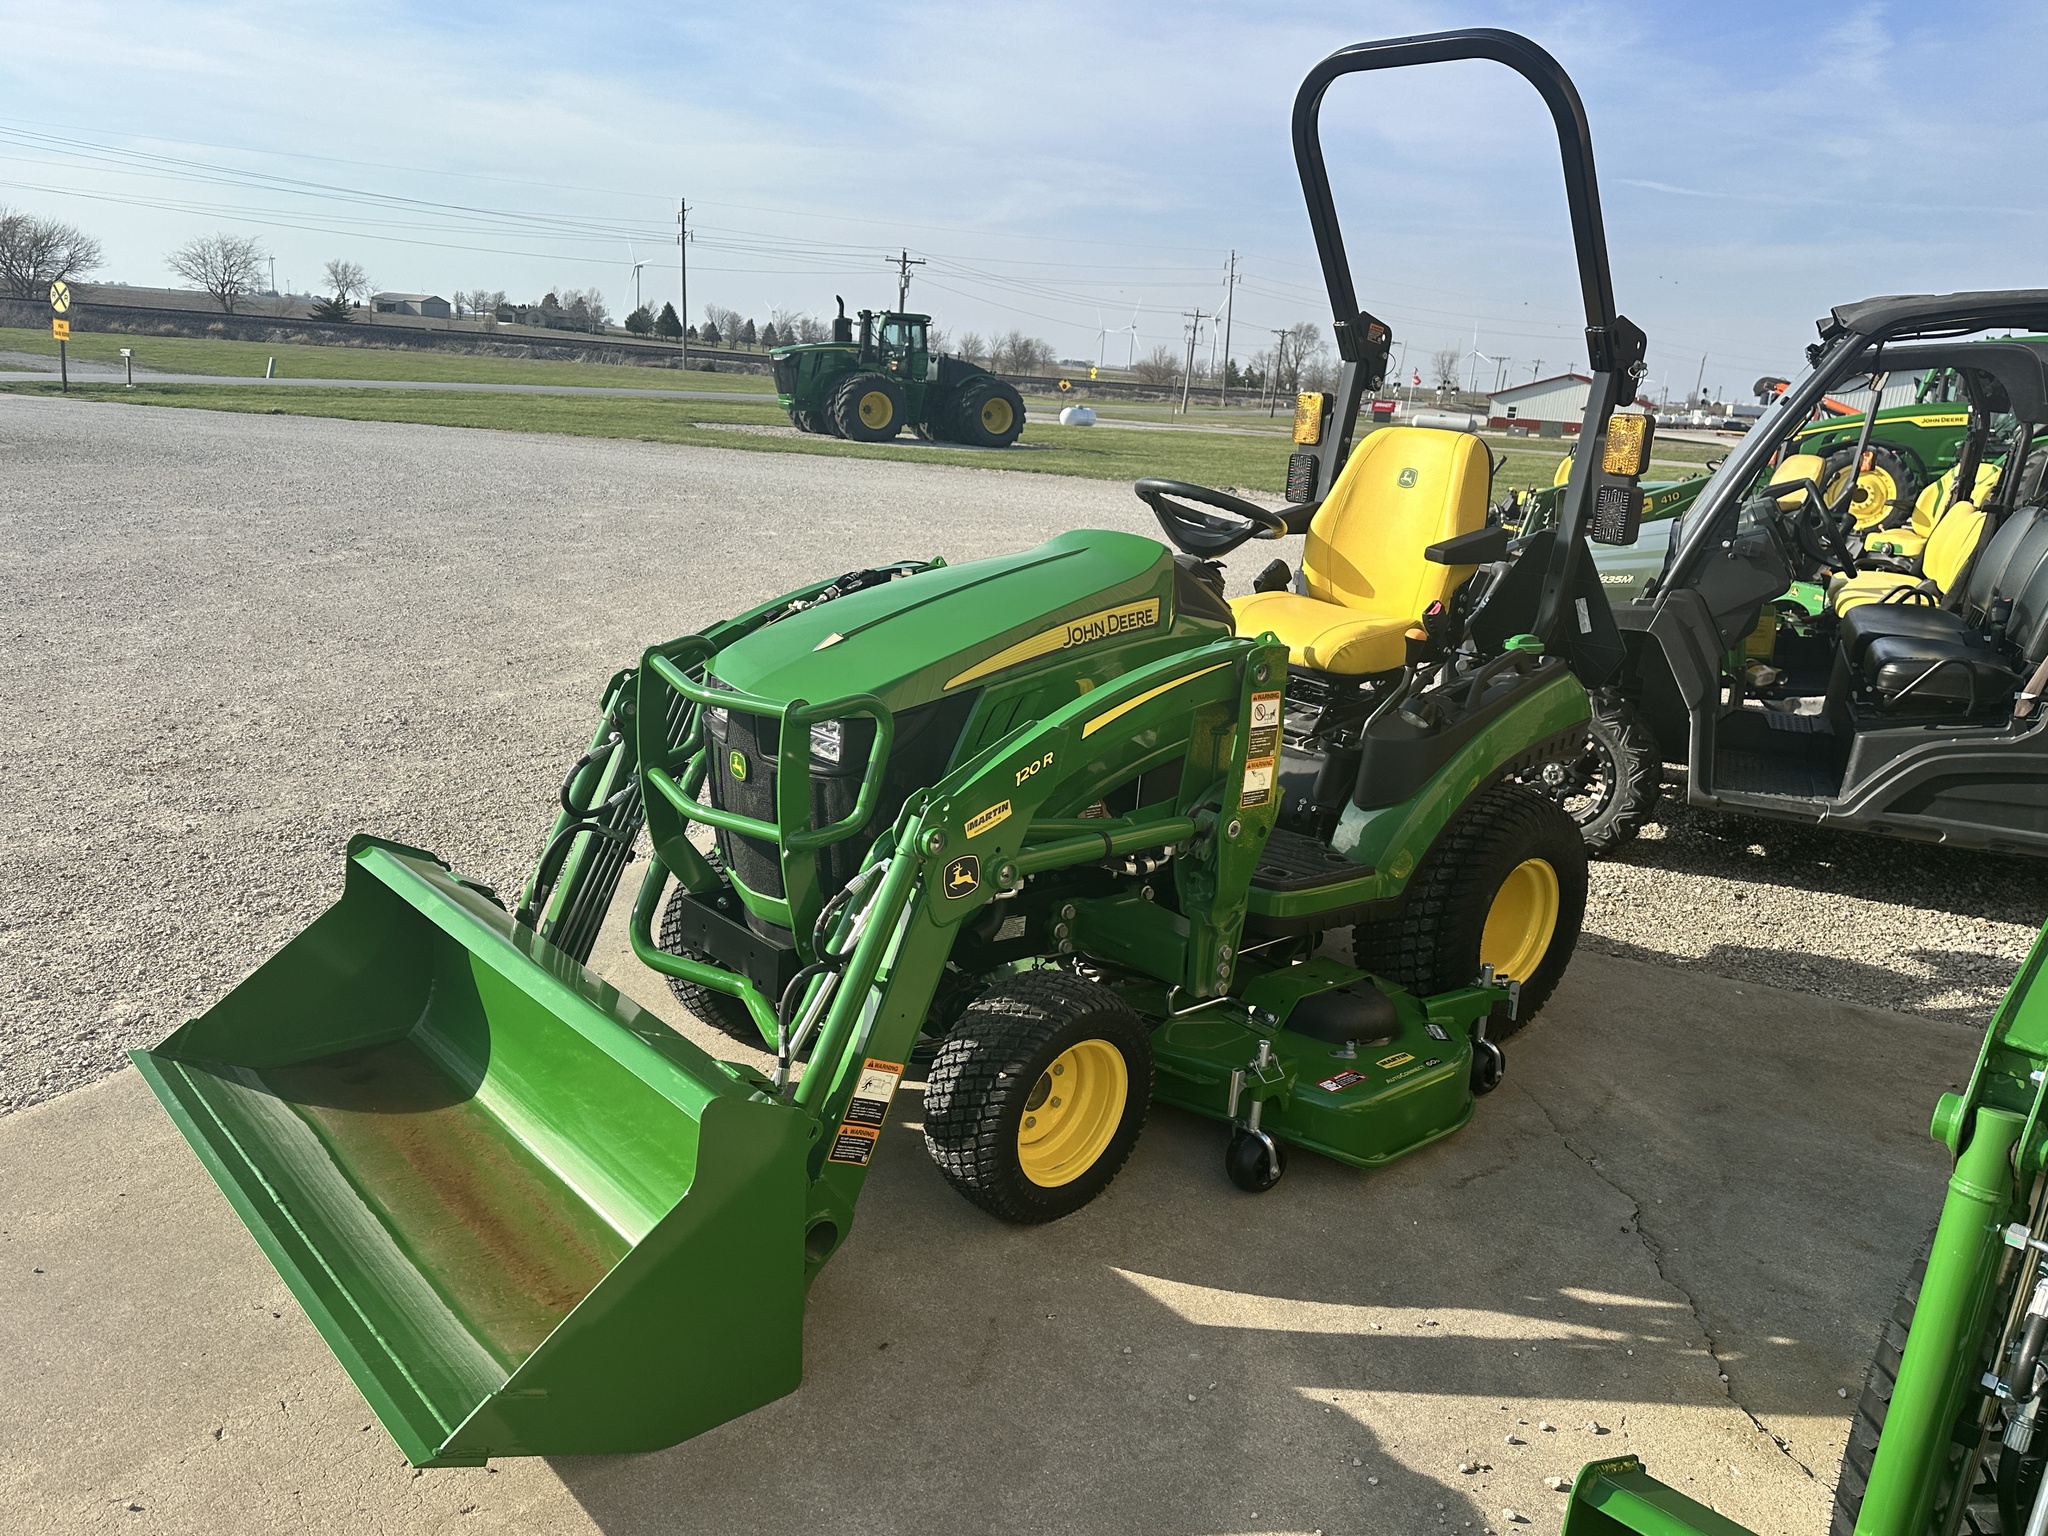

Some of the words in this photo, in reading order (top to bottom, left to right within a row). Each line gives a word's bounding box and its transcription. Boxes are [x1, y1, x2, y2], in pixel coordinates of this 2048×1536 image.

[1661, 492, 1680, 503] 410
[1063, 620, 1105, 647] JOHN
[1107, 609, 1154, 633] DEERE
[1257, 692, 1280, 701] WARNING
[1015, 760, 1041, 787] 120
[1043, 751, 1054, 768] R
[1250, 759, 1274, 769] WARNING
[967, 802, 1009, 832] MARTIN
[1381, 1053, 1409, 1066] MARTIN
[874, 1062, 899, 1072] WARNING
[850, 1128, 875, 1138] WARNING
